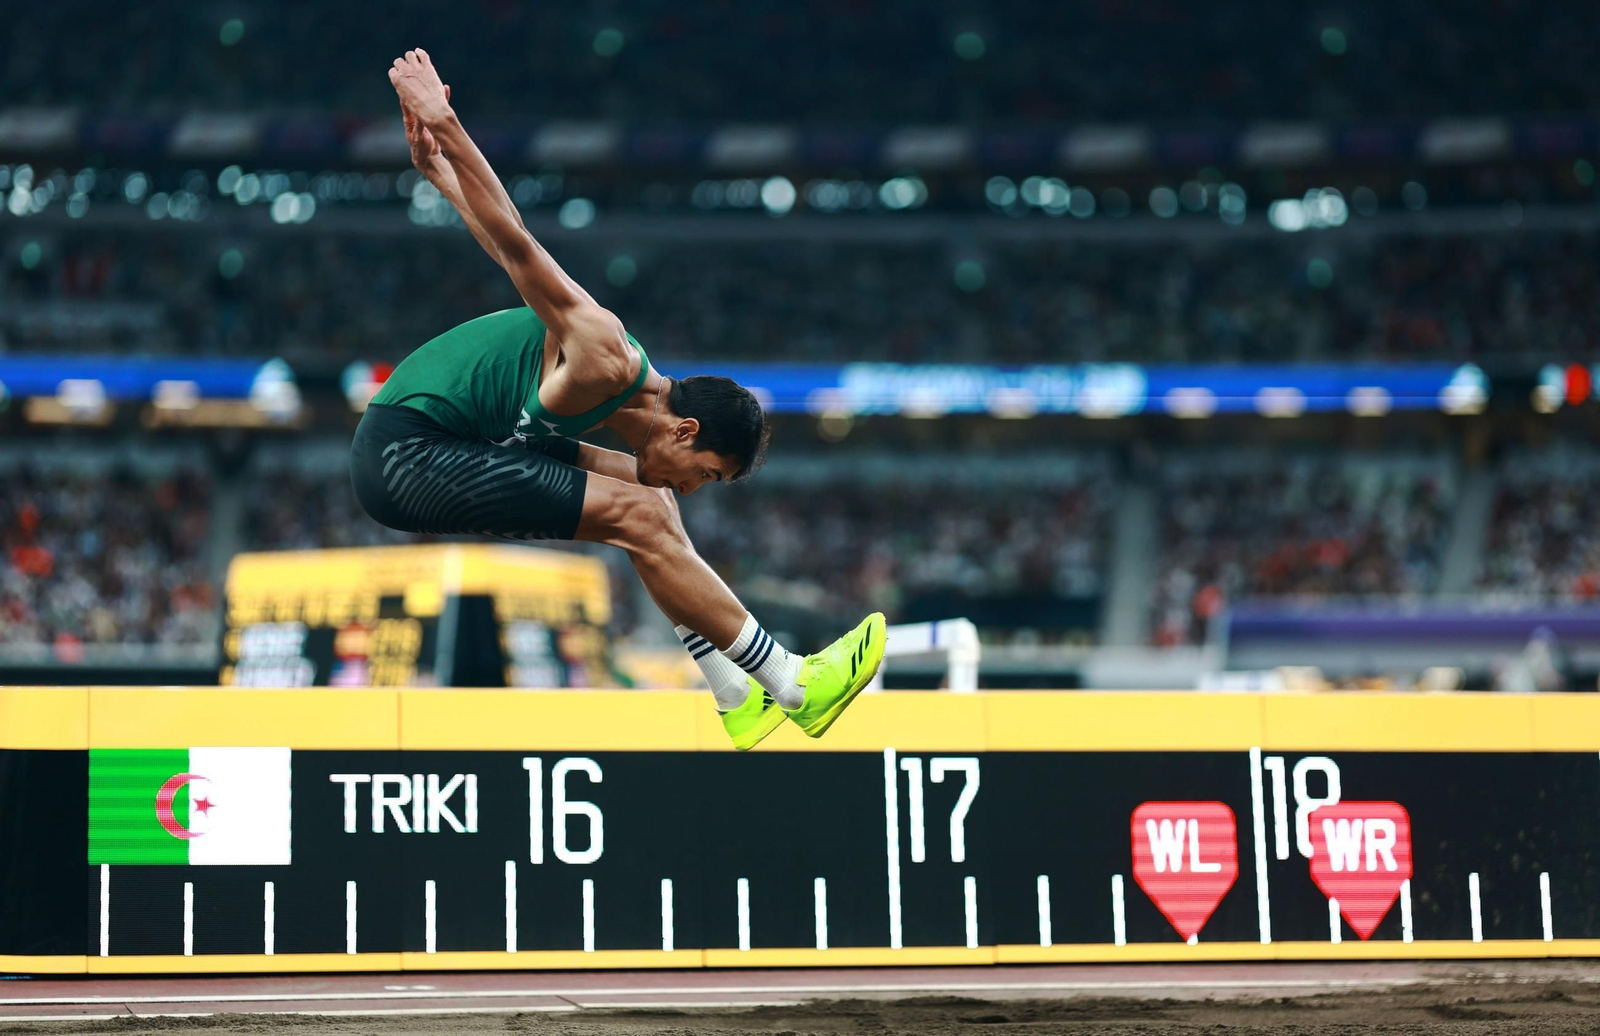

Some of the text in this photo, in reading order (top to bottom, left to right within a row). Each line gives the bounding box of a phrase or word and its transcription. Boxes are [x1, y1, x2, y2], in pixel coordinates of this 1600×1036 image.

[329, 773, 478, 834] TRIKI
[522, 757, 604, 865] 16
[900, 757, 980, 863] 17
[1263, 756, 1342, 860] 18
[1144, 818, 1223, 874] WL
[1321, 818, 1399, 873] WR
